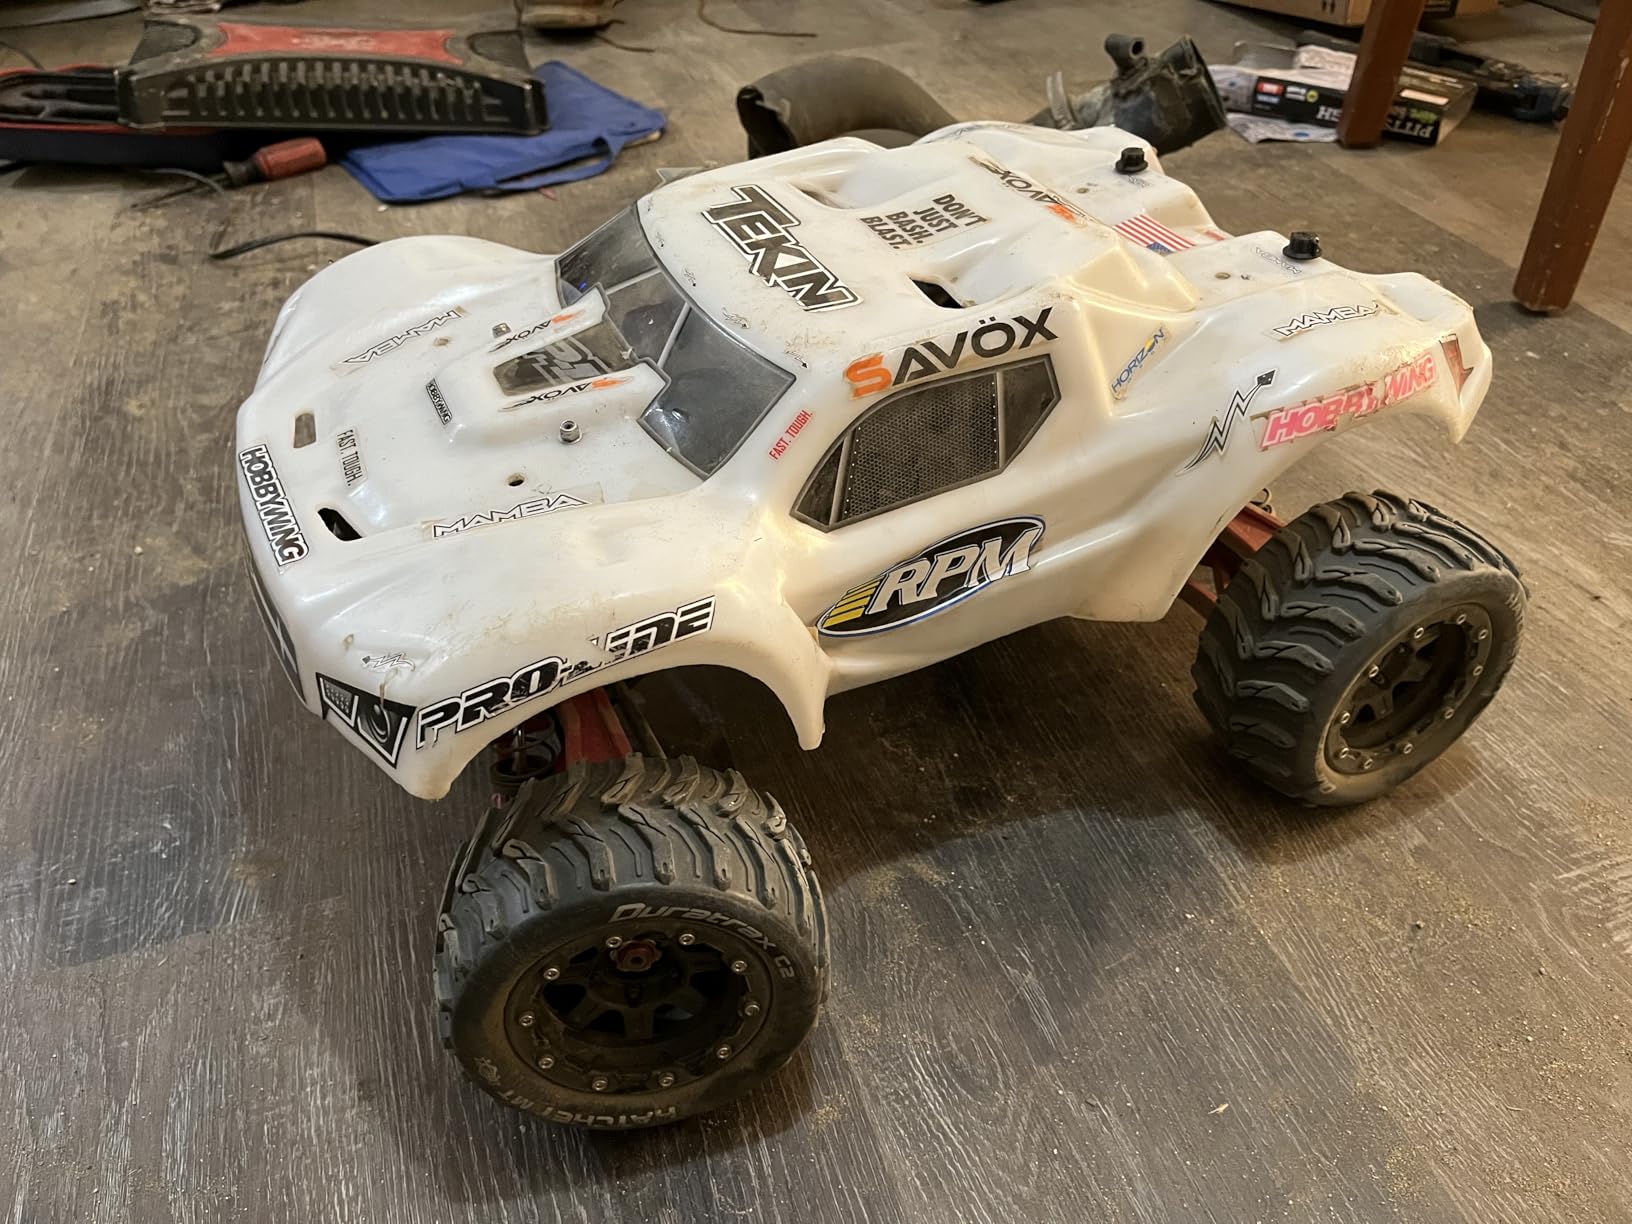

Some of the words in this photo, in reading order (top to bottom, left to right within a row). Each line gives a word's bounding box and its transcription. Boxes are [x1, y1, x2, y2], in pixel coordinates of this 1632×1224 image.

[860, 216, 912, 250] BLAST.
[885, 211, 933, 244] BASH.
[913, 207, 959, 233] JUST
[933, 194, 988, 226] DON'T
[701, 184, 863, 312] TEKIN
[343, 310, 462, 364] MAMBA
[1272, 303, 1379, 336] MAMBA
[846, 307, 1059, 399] SAVÖX
[1112, 327, 1164, 392] HORIZON
[336, 429, 357, 455] FAST.
[768, 437, 792, 460] FAST.
[785, 410, 813, 438] TOUGH.
[341, 450, 363, 486] TOUGH.
[239, 444, 309, 566] HOBBYWING
[433, 493, 590, 538] MAMBA
[865, 526, 1043, 615] RPM
[608, 902, 777, 951] Duratrax
[775, 954, 795, 979] C2
